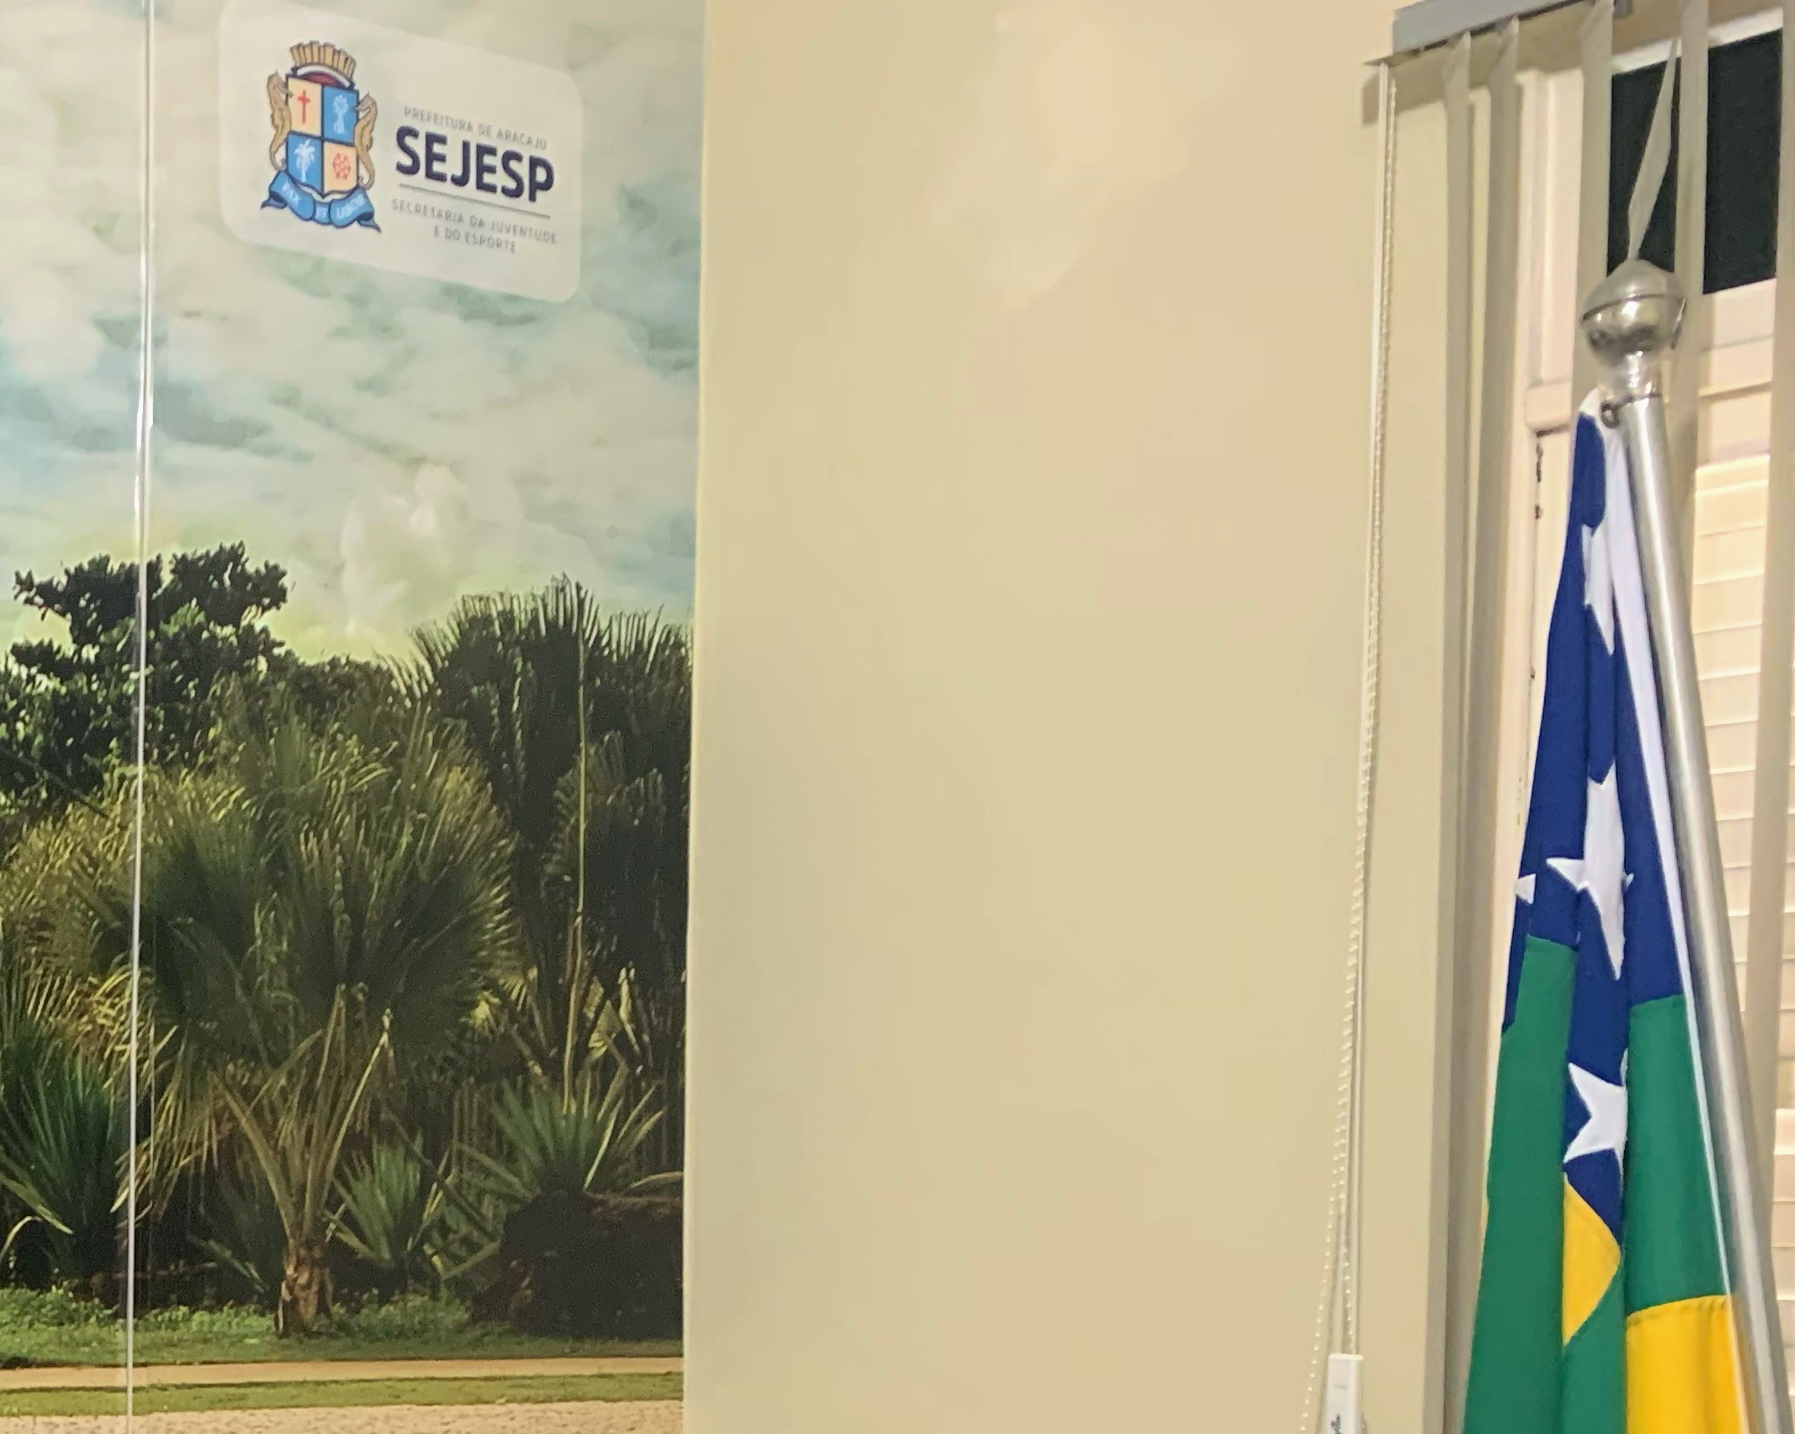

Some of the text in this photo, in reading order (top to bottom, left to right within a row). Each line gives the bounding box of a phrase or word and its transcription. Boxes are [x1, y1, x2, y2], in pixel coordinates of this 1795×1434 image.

[404, 105, 547, 150] PREFEITURA DE ARACAJU
[396, 125, 554, 202] SEJESP
[392, 198, 464, 224] SECRETARIA
[470, 215, 485, 229] DA
[490, 219, 557, 245] JUVENTUDE
[434, 225, 516, 253] E DO ESPORTE
